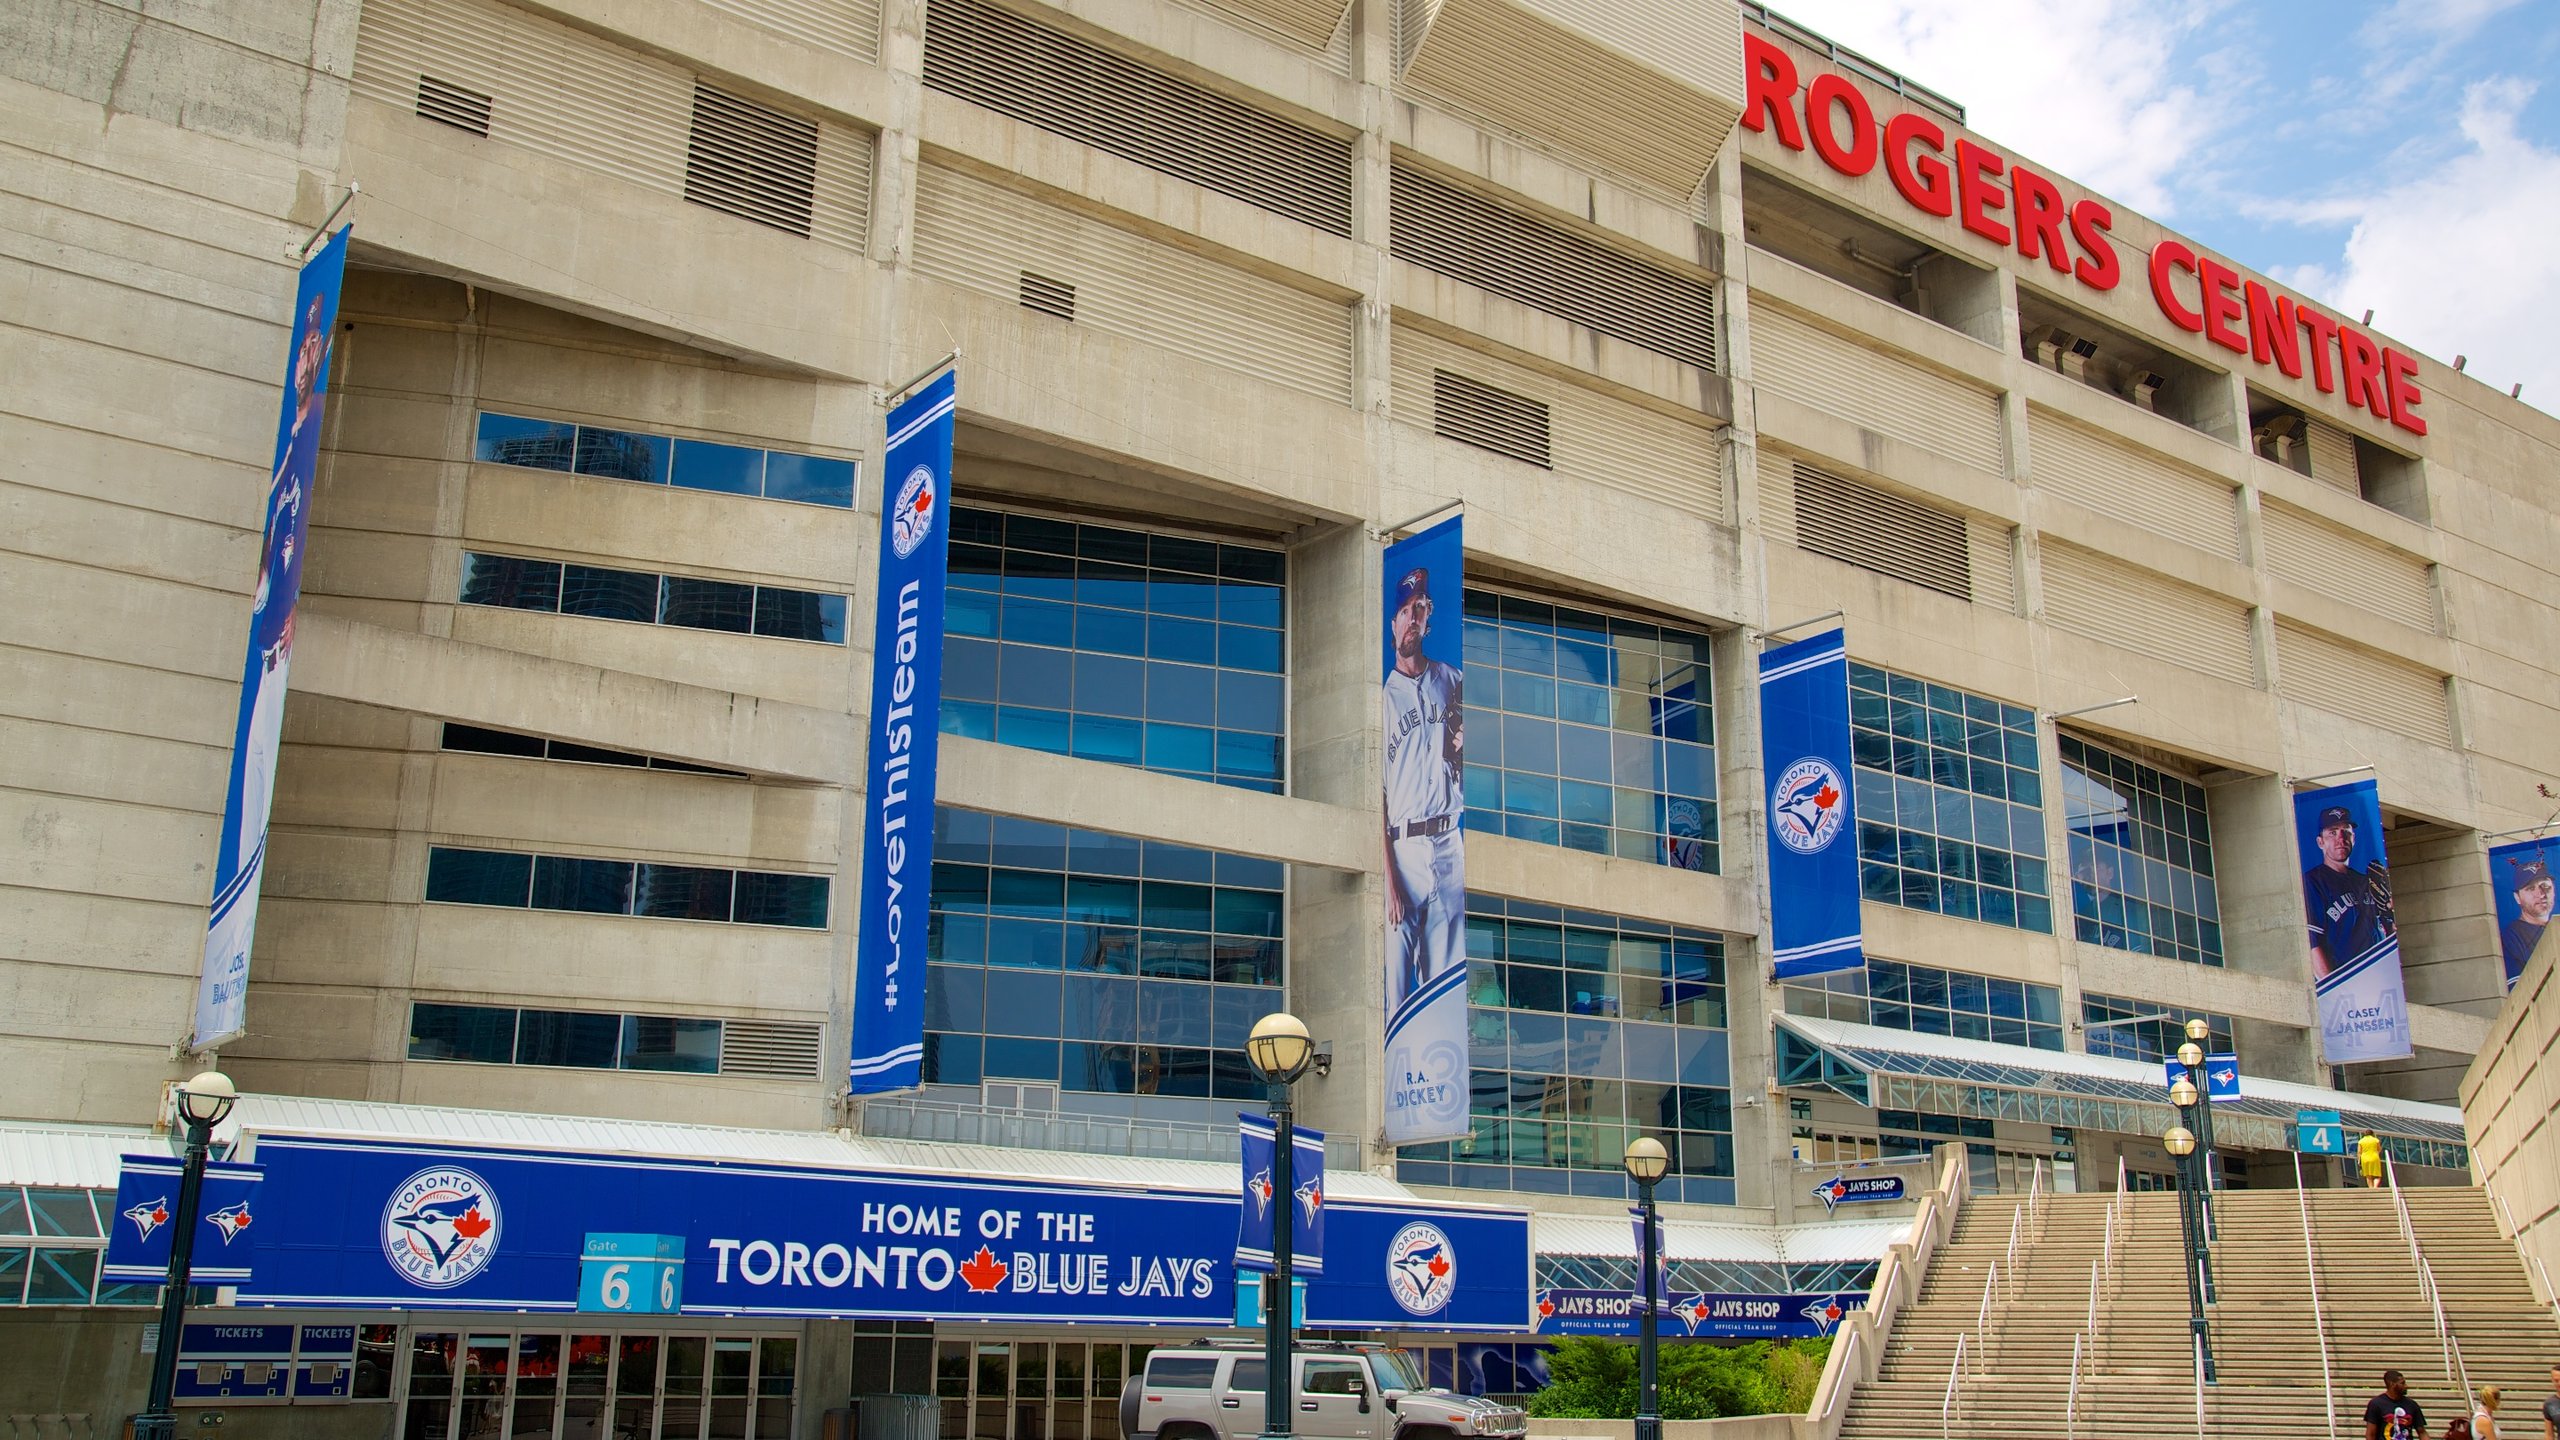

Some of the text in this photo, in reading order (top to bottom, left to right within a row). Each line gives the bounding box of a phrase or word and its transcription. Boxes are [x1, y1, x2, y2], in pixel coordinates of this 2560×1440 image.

[1741, 31, 2428, 437] ROGERS CENTRE
[896, 472, 924, 511] TORONTO
[893, 514, 930, 553] BLUE JAYS
[1387, 703, 1448, 763] BLUE JA
[883, 578, 920, 1013] #LoveThisTeam
[1778, 764, 1821, 802] TORONTO
[1779, 811, 1839, 848] BLUE JAYS
[229, 951, 245, 973] JOSE
[2336, 1017, 2395, 1034] JANSSEN
[2347, 1006, 2381, 1019] CASEY
[1406, 1070, 1429, 1086] R.A.
[1396, 1084, 1446, 1108] DICKEY
[2312, 1127, 2331, 1151] 4
[396, 1175, 472, 1211] TORONTO
[1848, 1180, 1896, 1192] JAYS SHOP
[861, 1202, 1095, 1243] HOME OF THE
[588, 1240, 618, 1252] Gate
[1393, 1229, 1437, 1257] TORONTO
[391, 1238, 486, 1280] BLUE JAYS
[708, 1238, 1214, 1299] TORONTO BLUE JAYS
[601, 1263, 675, 1310] 6 6
[1393, 1277, 1449, 1309] BLUE JAYS
[1559, 1296, 1593, 1315] JAYS
[1712, 1300, 1780, 1318] JAYS SHOP
[214, 1327, 264, 1339] TICKETS
[304, 1328, 352, 1340] TICKETS
